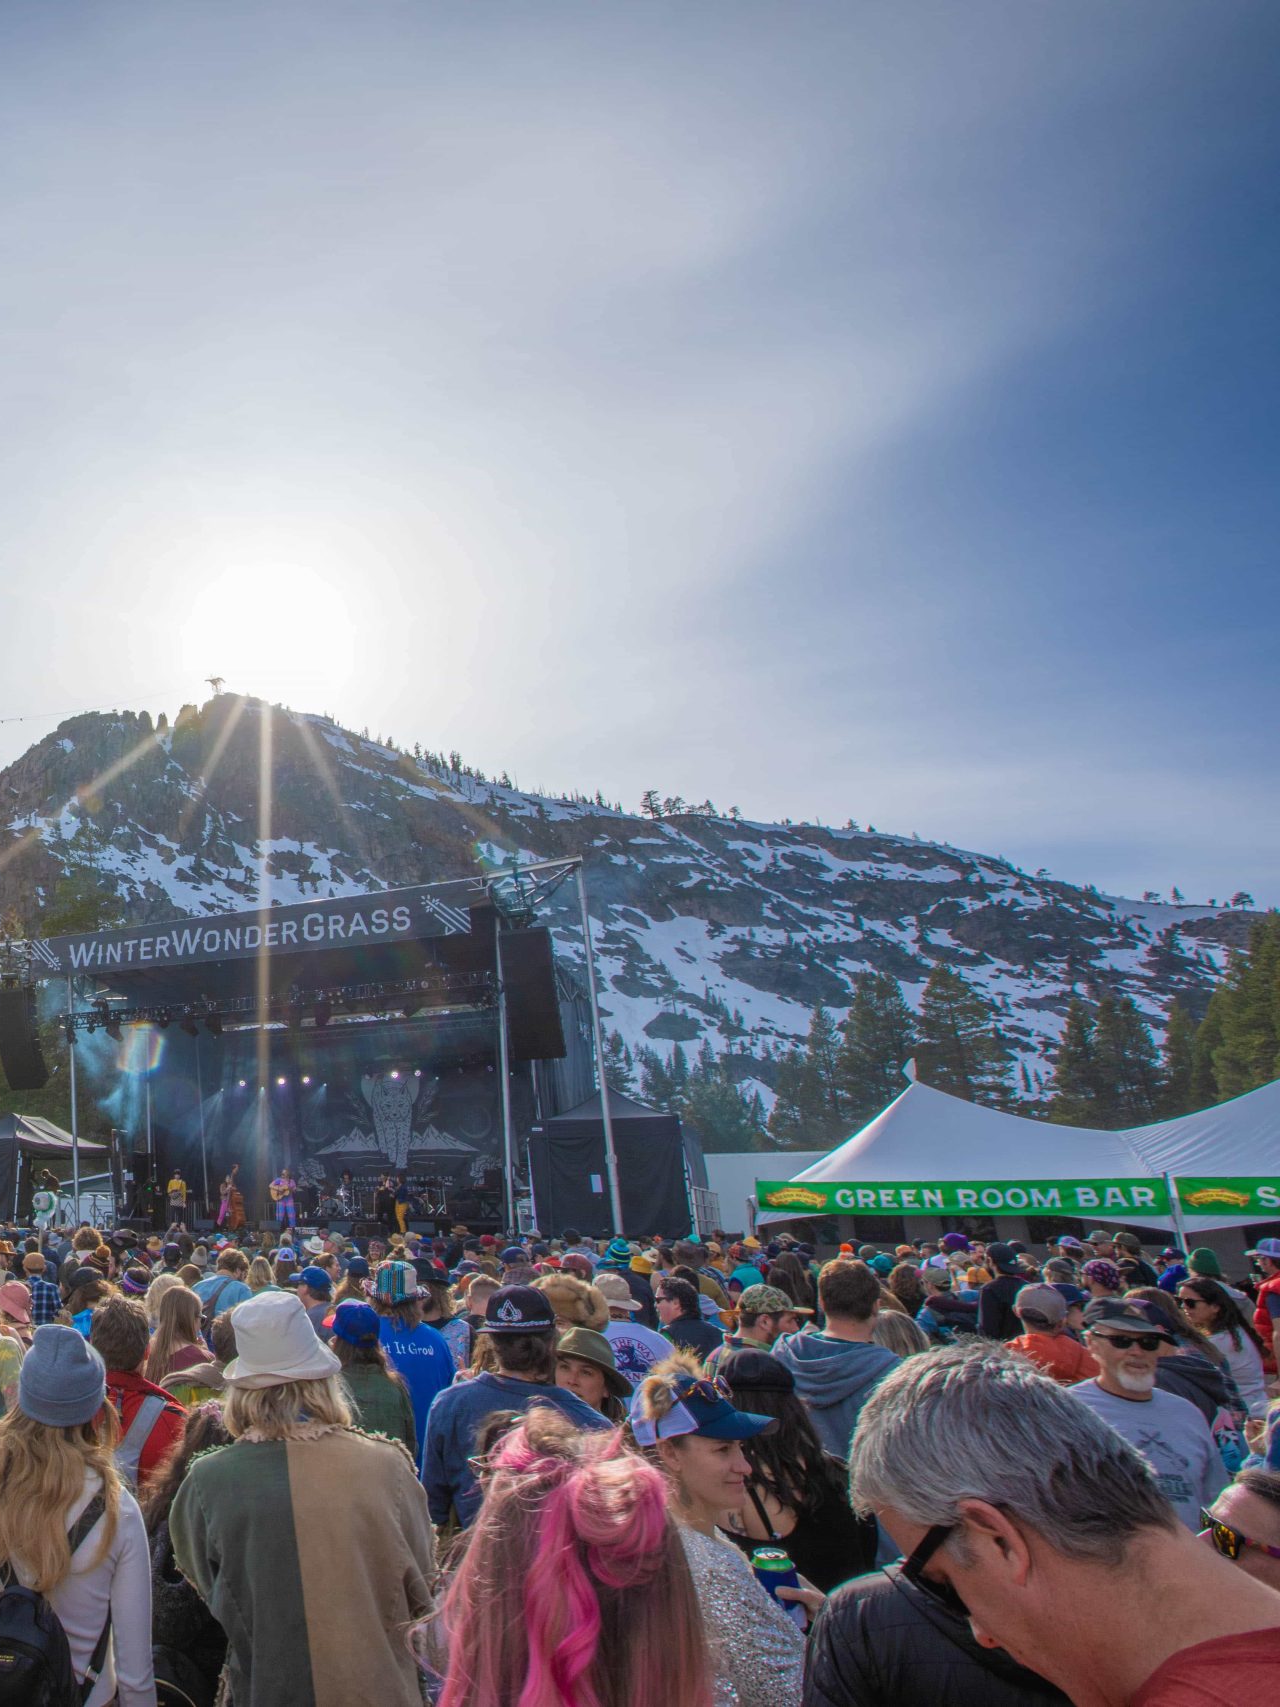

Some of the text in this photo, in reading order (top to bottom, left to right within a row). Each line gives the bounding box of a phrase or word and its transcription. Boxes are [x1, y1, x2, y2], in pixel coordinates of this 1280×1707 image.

[835, 1186, 1157, 1209] GREEN ROOM BAR
[382, 1341, 434, 1356] et It Grow
[612, 1337, 633, 1348] THE
